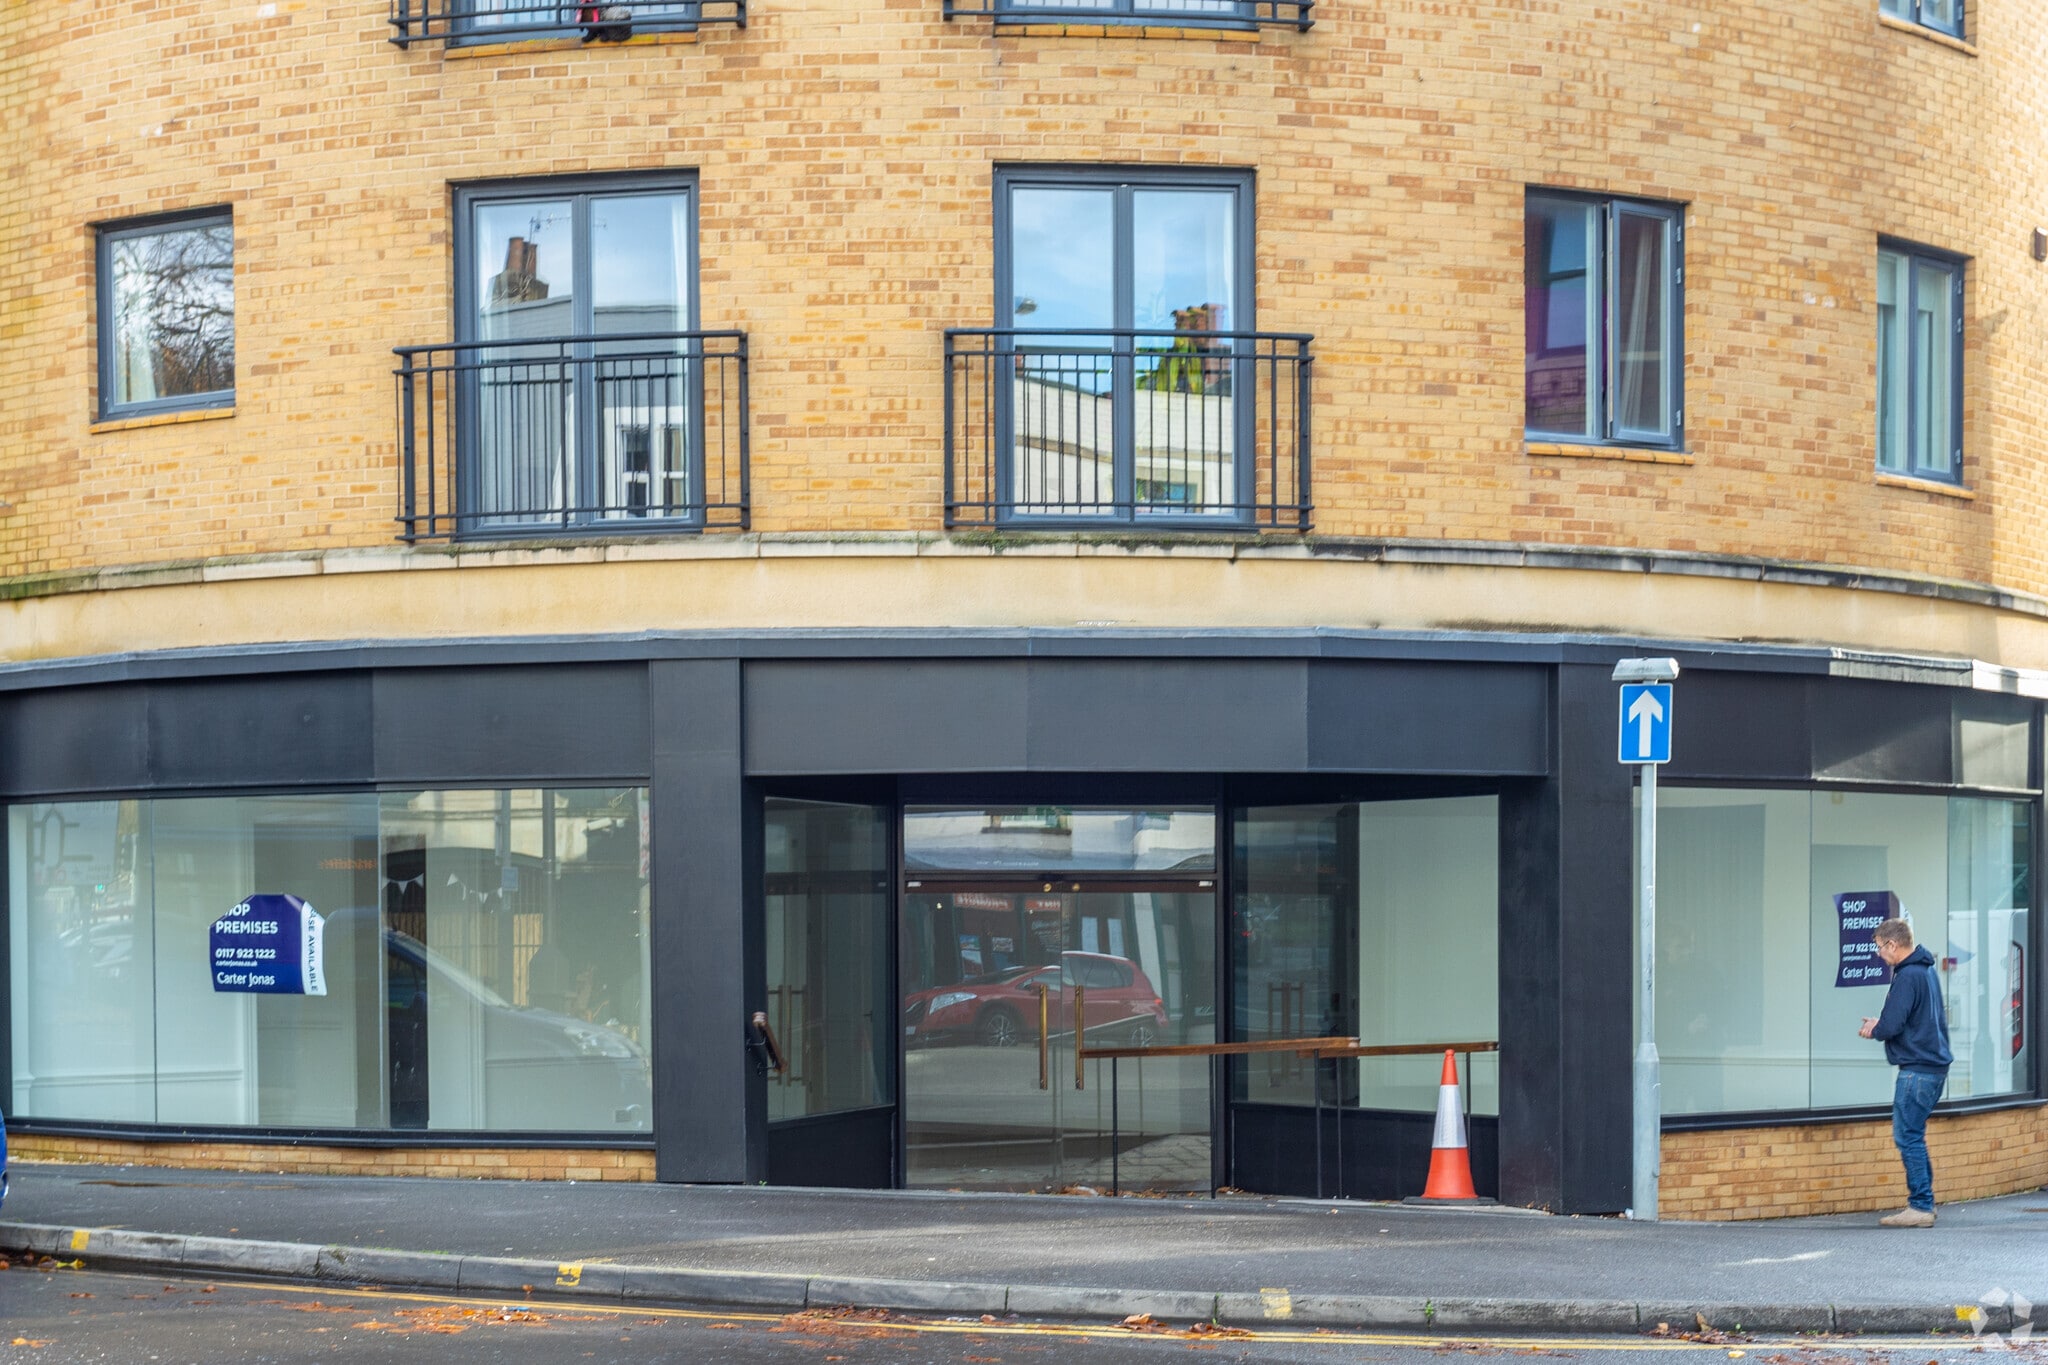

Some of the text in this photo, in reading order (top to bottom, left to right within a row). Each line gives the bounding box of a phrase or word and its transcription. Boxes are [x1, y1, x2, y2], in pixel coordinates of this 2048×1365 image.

[224, 903, 250, 917] OP
[1842, 900, 1867, 913] SHOP
[215, 920, 278, 934] PREMISES
[215, 948, 276, 959] 0117 922 1222
[1842, 944, 1856, 953] 0117
[308, 936, 319, 991] AVAILABLE
[217, 971, 275, 987] Carter Jonas
[1842, 965, 1882, 980] Carter Jonas
